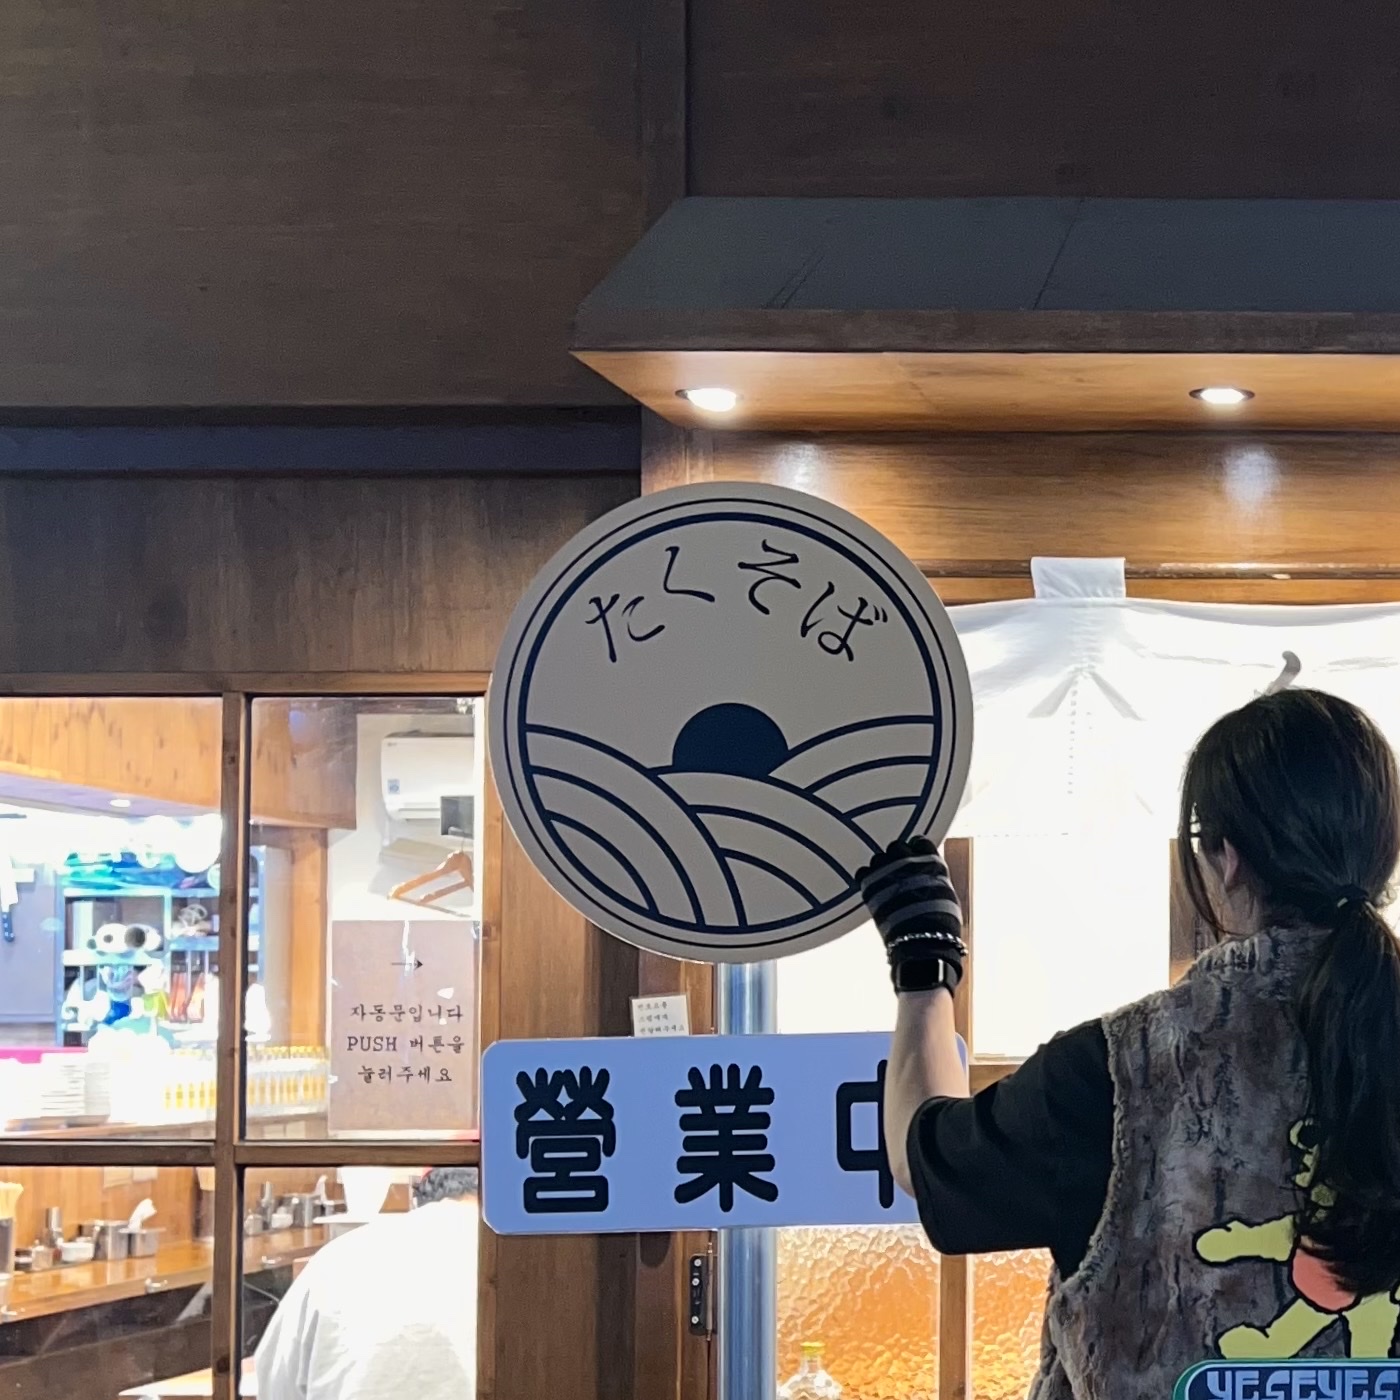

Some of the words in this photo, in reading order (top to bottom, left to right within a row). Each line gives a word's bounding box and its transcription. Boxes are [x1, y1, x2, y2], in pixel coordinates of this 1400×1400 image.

[585, 539, 888, 663] たくそば
[350, 1003, 463, 1023] 자동문입니다
[347, 1036, 398, 1052] PUSH
[409, 1035, 465, 1054] 버튼을
